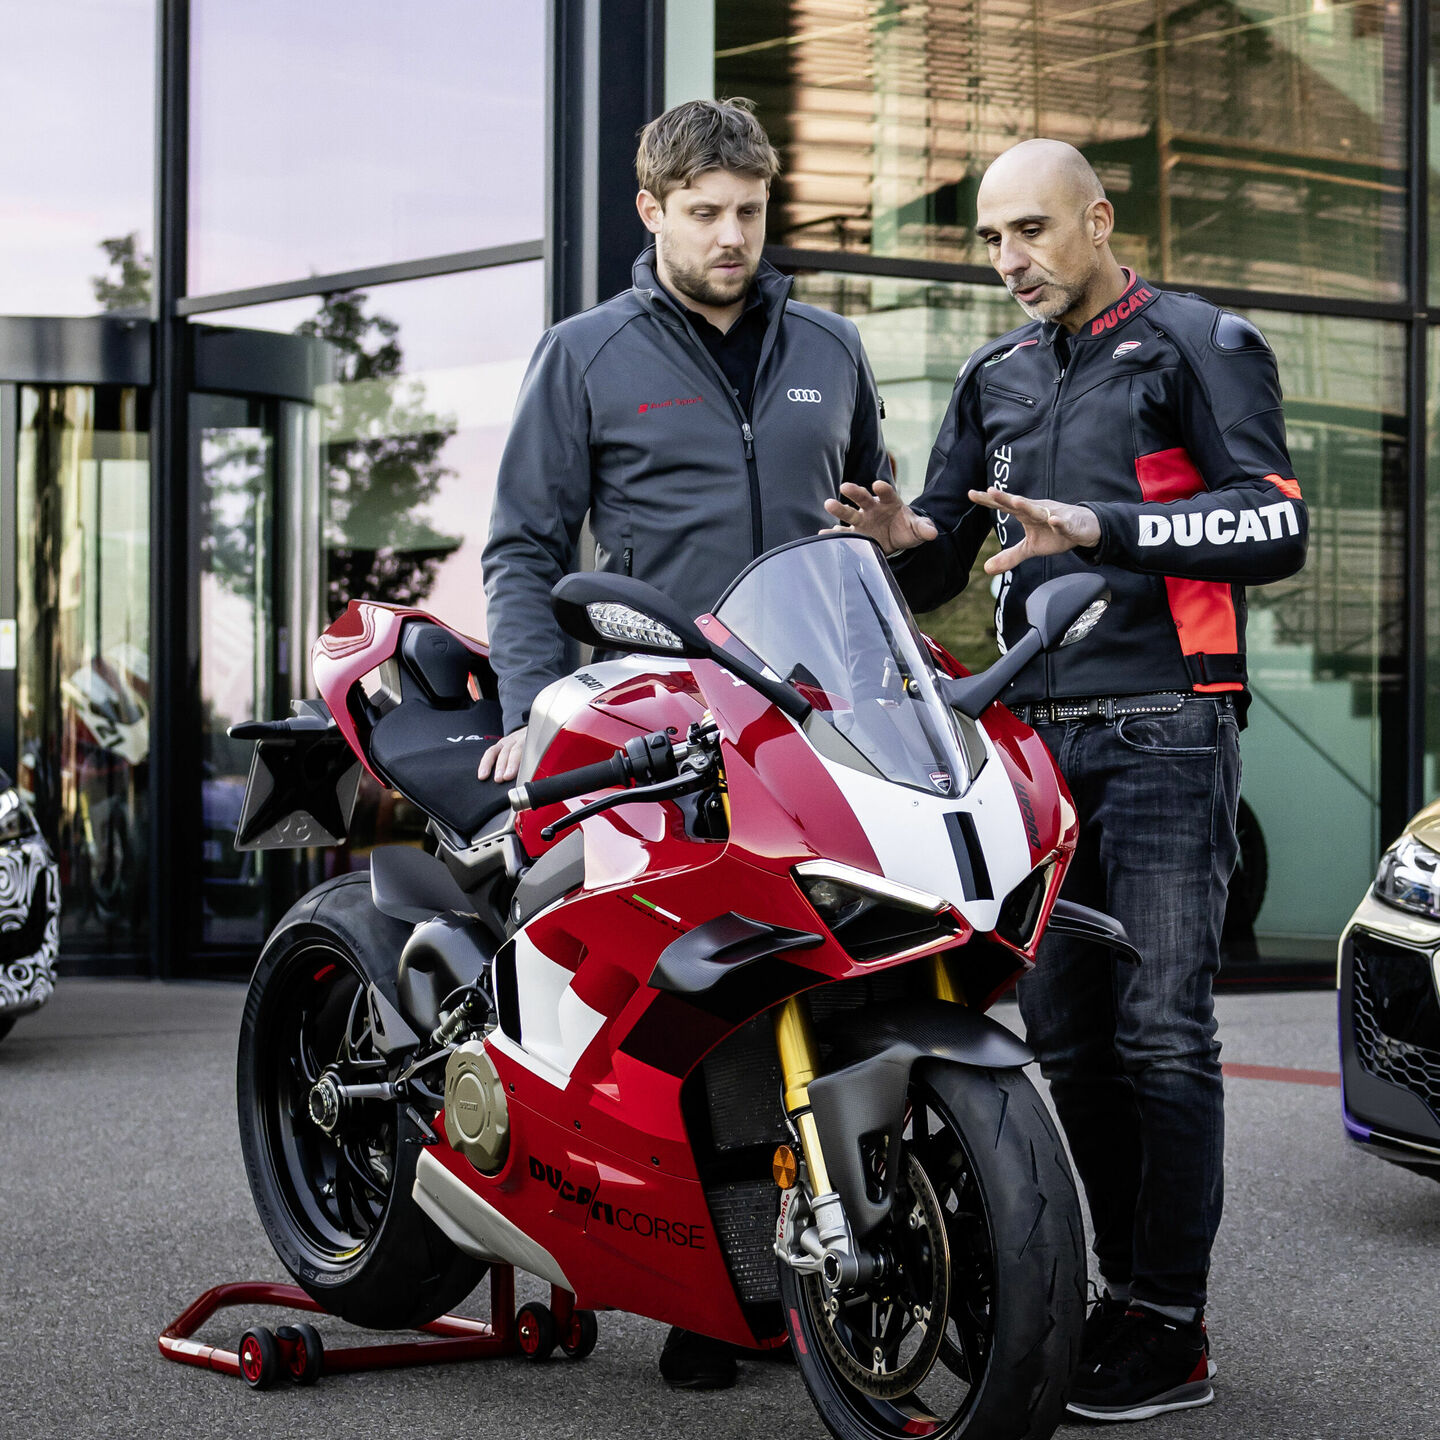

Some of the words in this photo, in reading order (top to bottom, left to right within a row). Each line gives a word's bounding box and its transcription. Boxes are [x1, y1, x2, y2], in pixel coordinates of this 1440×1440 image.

[1091, 287, 1153, 336] DUCATI
[1137, 500, 1300, 547] DUCATI
[1013, 780, 1042, 850] DUCATI
[778, 1193, 790, 1239] brembo
